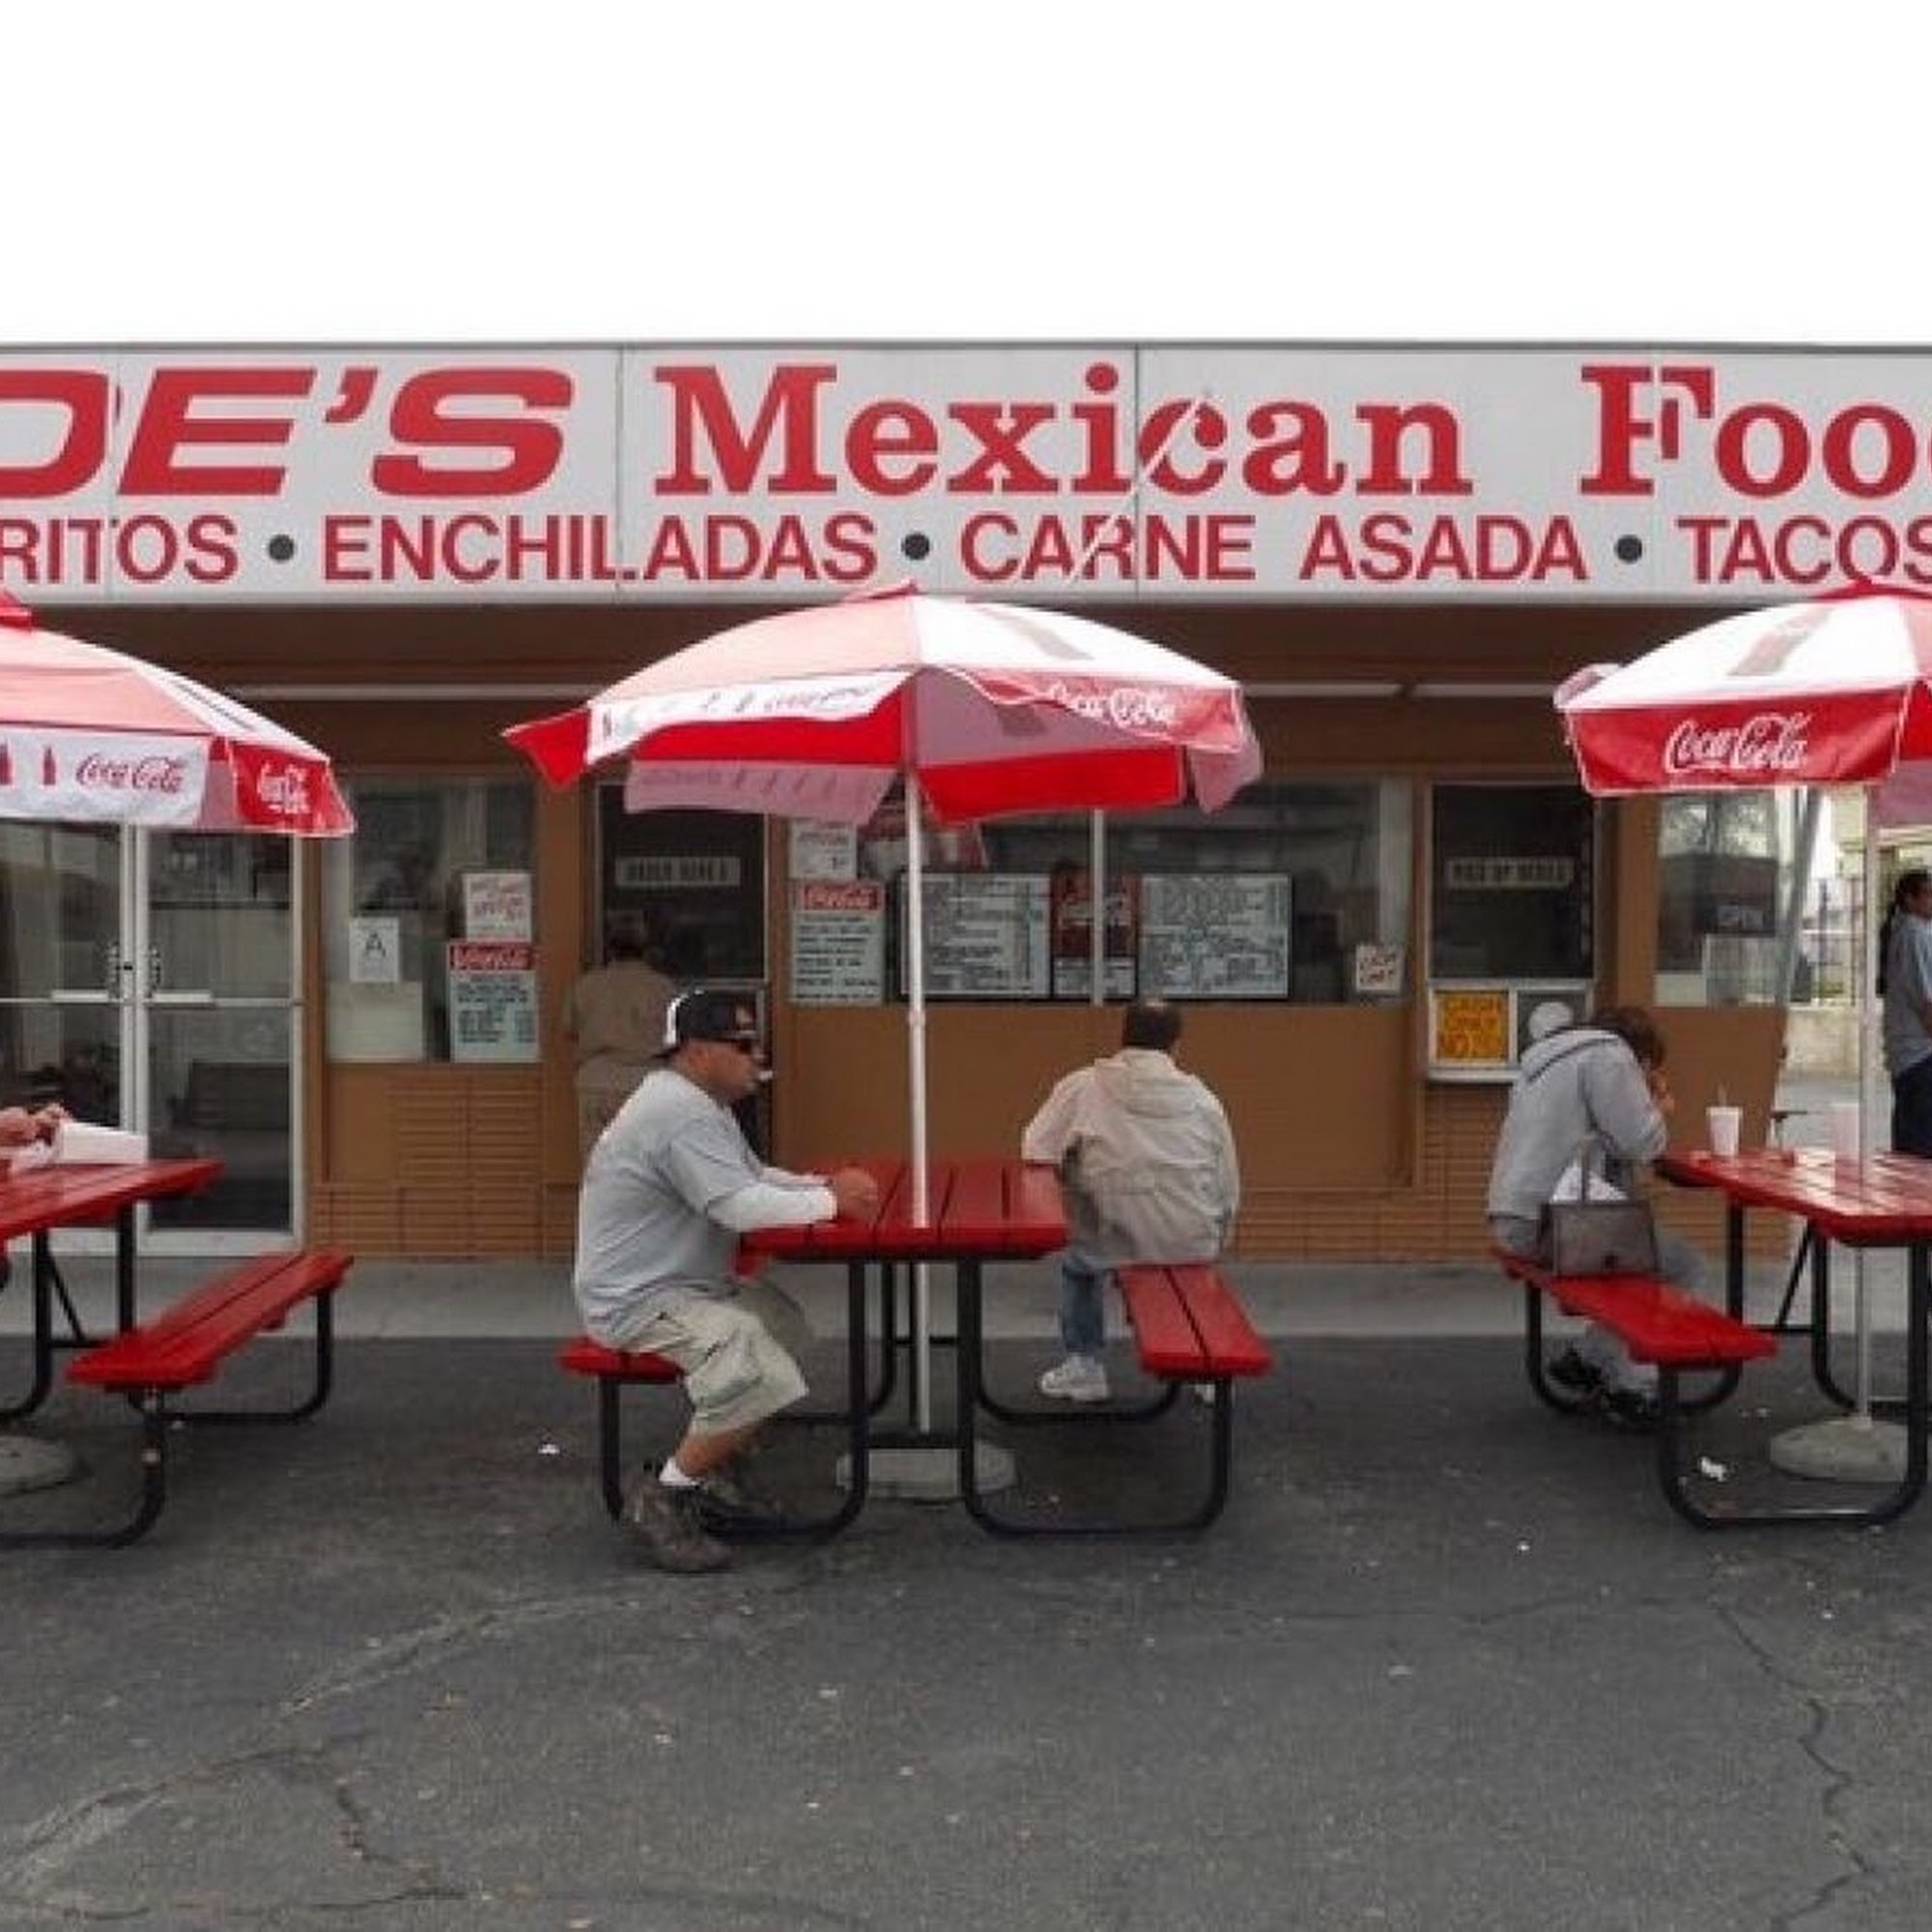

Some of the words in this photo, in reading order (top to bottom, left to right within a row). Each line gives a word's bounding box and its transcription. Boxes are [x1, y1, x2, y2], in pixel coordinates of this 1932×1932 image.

[654, 362, 1472, 497] Mexican
[1581, 364, 1932, 500] Foo
[324, 514, 878, 582] ENCHILADAS
[959, 513, 1257, 582] CARNE
[1300, 513, 1588, 582] ASADA
